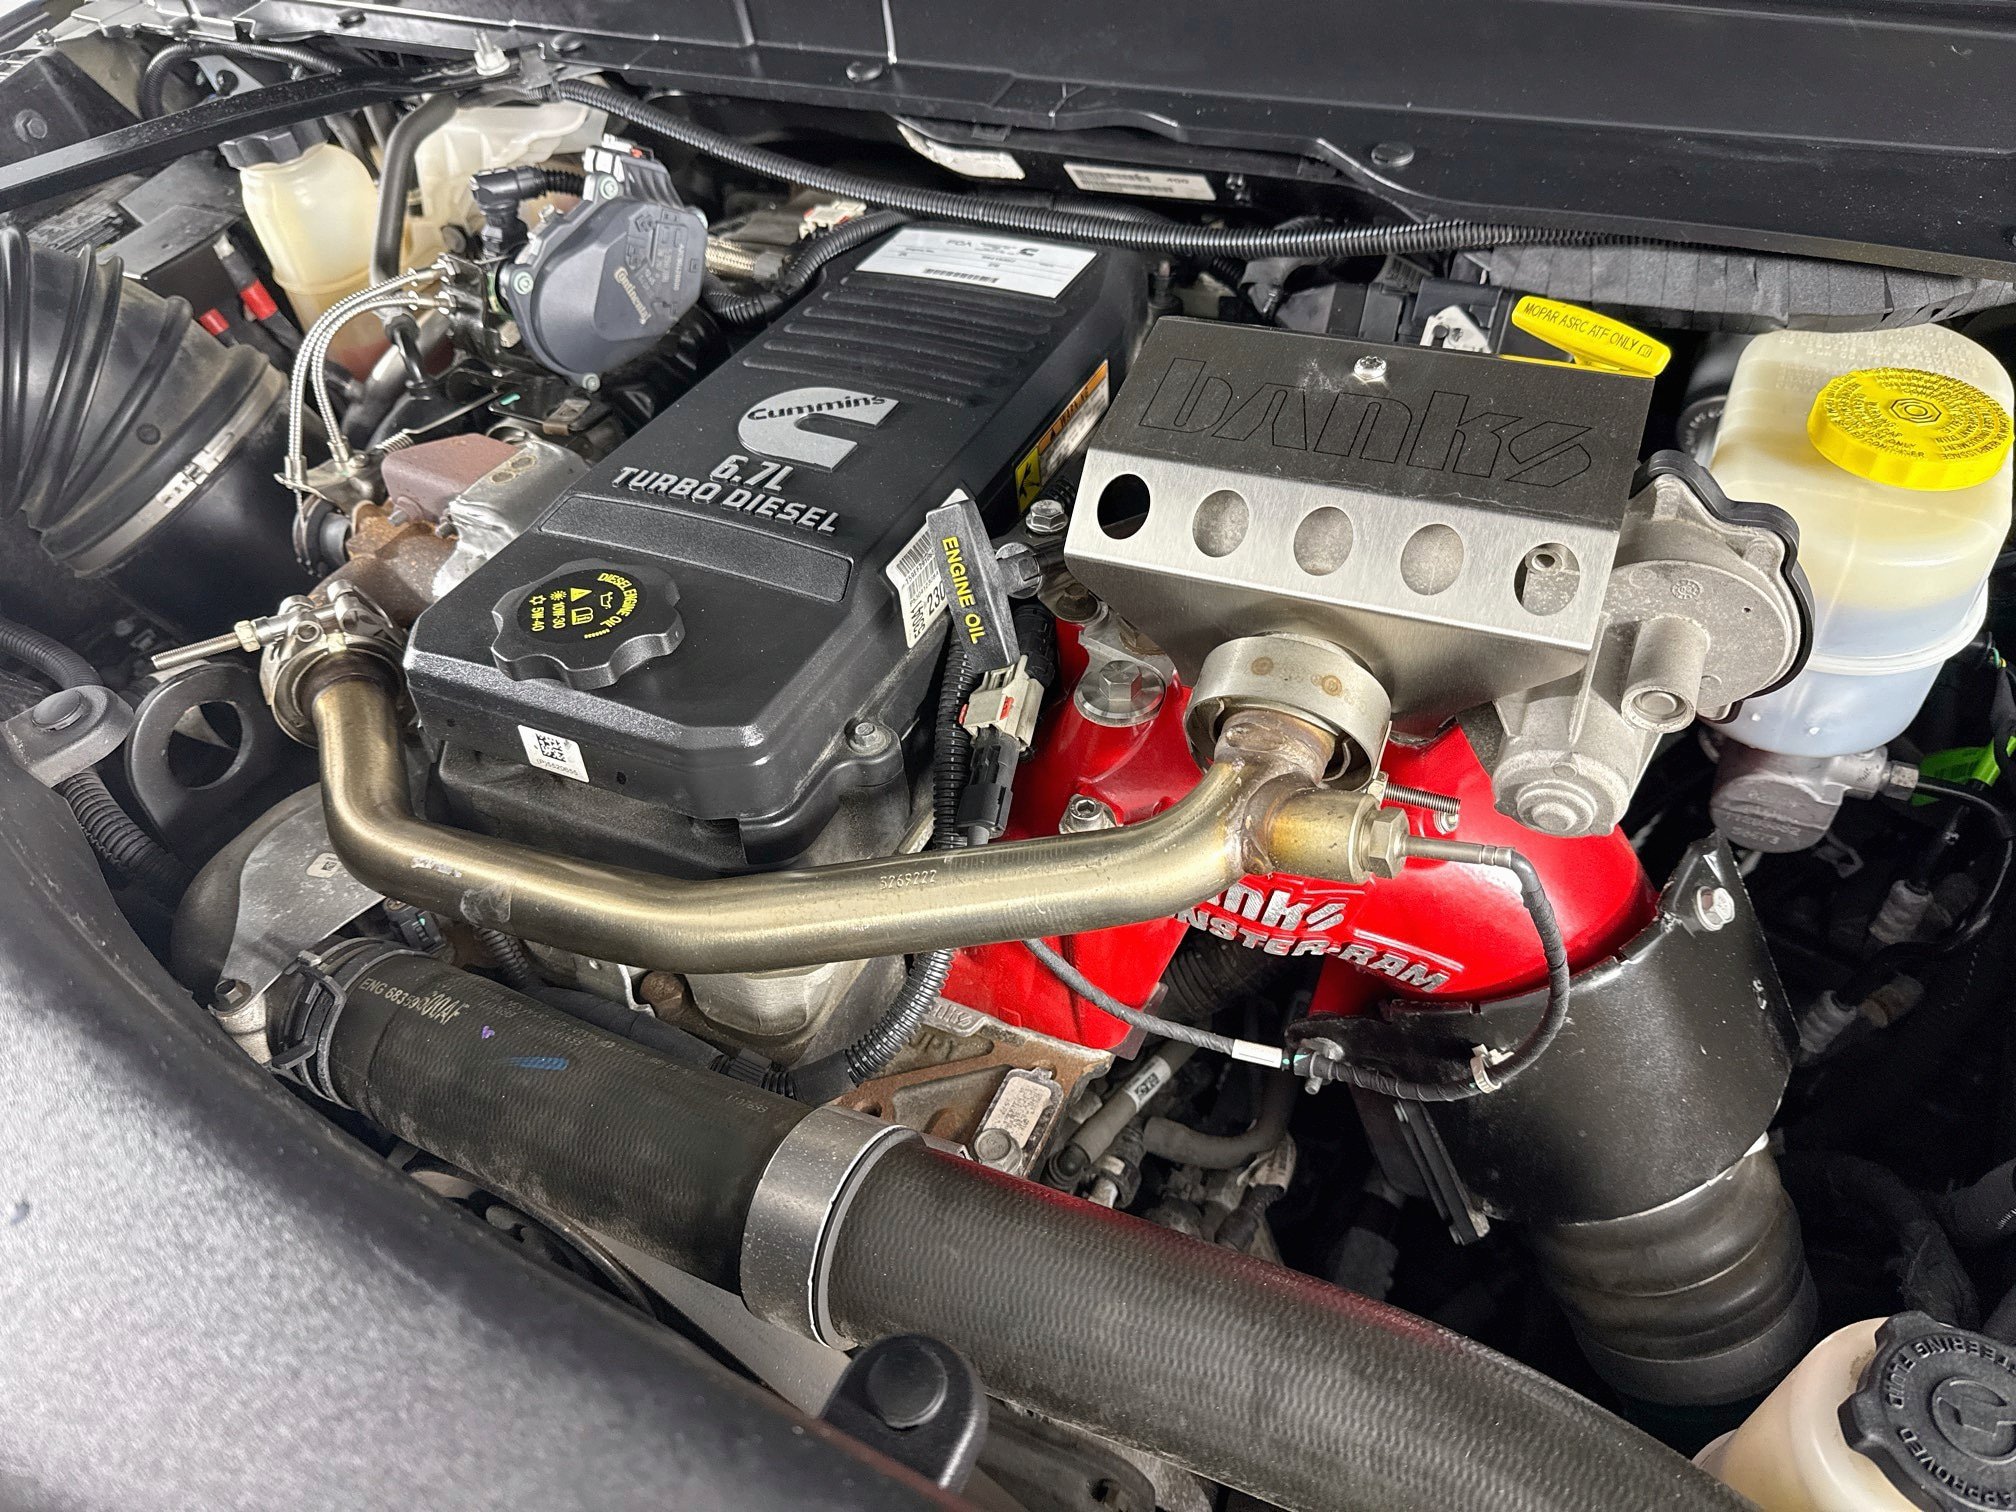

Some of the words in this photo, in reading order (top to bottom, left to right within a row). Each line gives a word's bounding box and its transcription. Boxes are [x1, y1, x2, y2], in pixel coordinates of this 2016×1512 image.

[613, 266, 652, 325] Continental
[1523, 302, 1560, 323] MOPAR
[1558, 314, 1590, 333] ASRC
[1588, 324, 1612, 340] ATF
[1609, 332, 1640, 351] ONLY
[747, 394, 888, 422] Cummins
[709, 454, 794, 493] 6.7L
[611, 466, 724, 505] TURBO
[719, 487, 841, 536] DIESEL
[597, 572, 633, 590] DIESEL
[942, 536, 976, 608] ENGINE
[964, 613, 986, 645] OIL
[531, 606, 545, 632] 5W-40
[552, 602, 566, 629] 10W-30
[600, 615, 623, 628] OIL
[621, 588, 638, 617] ENGINE
[1207, 883, 1346, 932] nks
[1174, 907, 1450, 993] NSTER-RAM
[359, 977, 388, 995] ENG
[1885, 1354, 1917, 1409] FLUID
